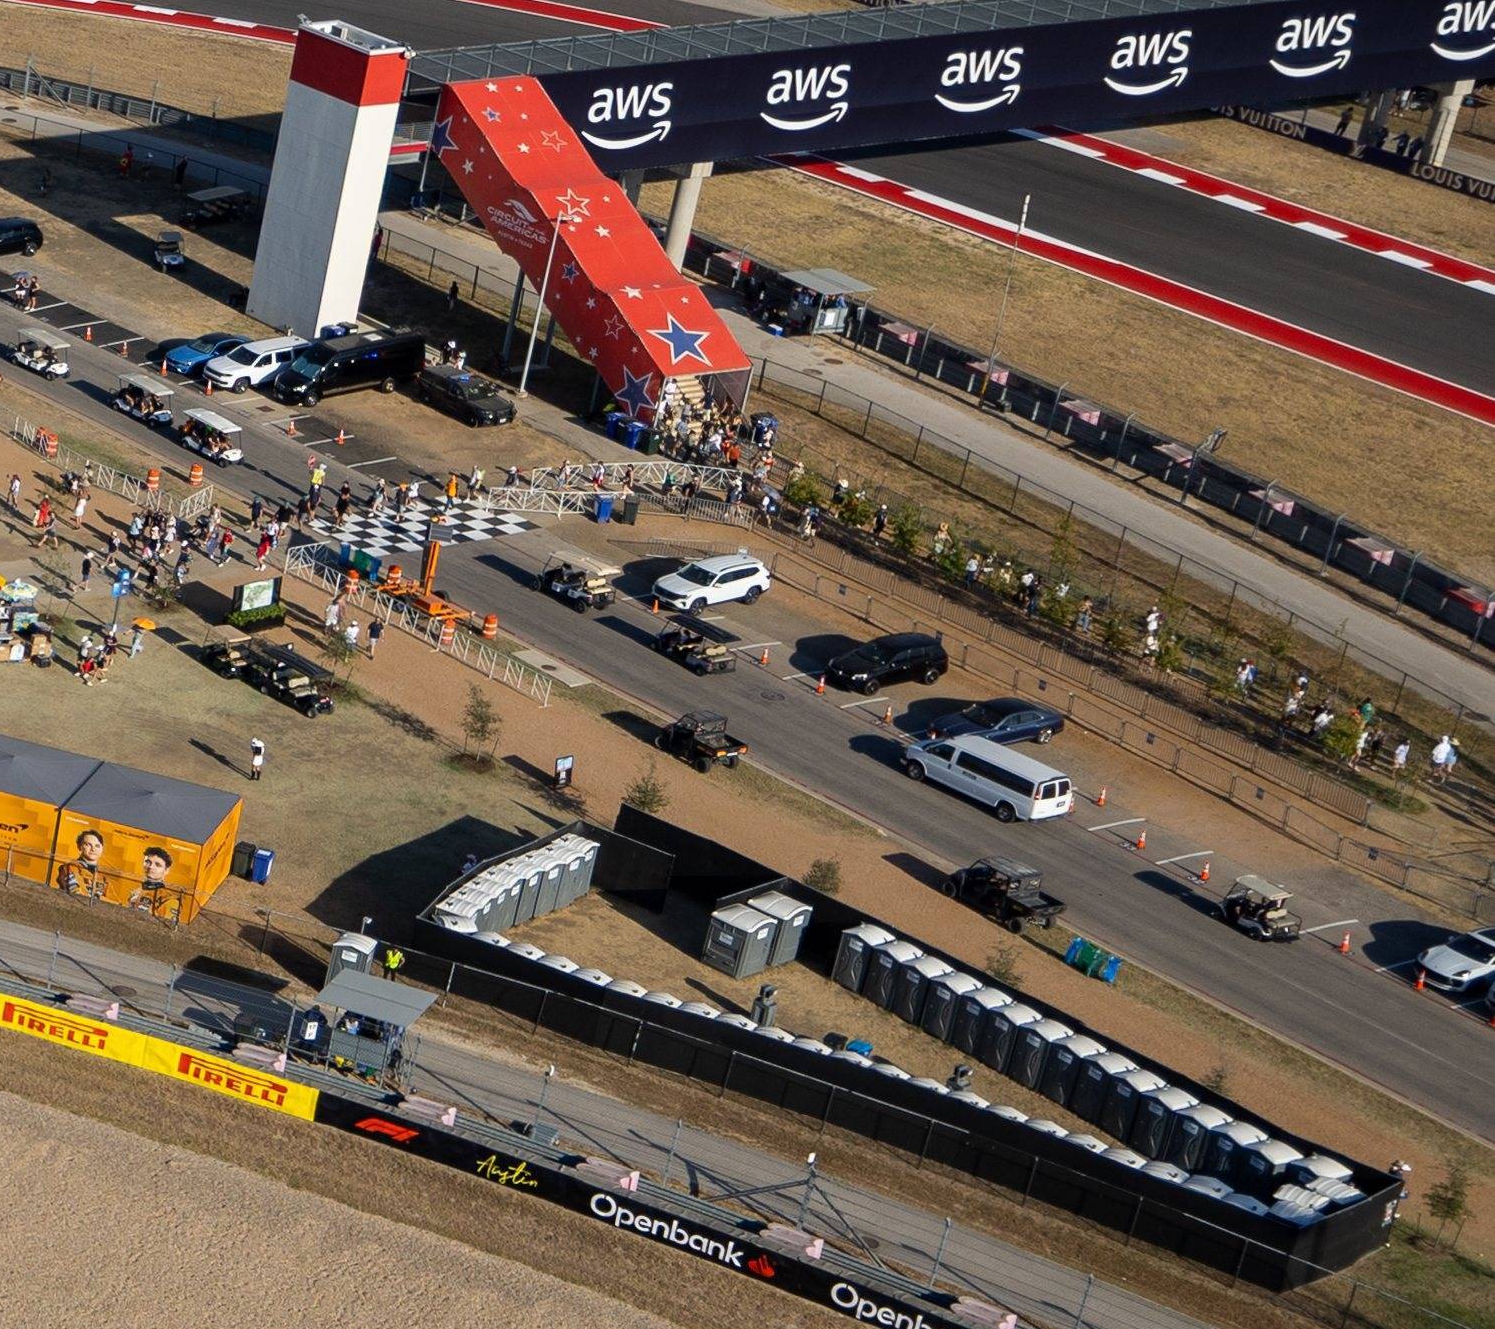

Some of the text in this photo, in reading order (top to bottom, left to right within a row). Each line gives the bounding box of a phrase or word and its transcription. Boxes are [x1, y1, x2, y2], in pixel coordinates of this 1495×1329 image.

[1110, 31, 1193, 70] aws
[1277, 14, 1356, 52] aws
[767, 64, 851, 105] aws
[941, 46, 1024, 87] aws
[588, 83, 674, 123] aws
[1411, 159, 1463, 190] LOUIS
[2, 1001, 110, 1050] PIRELLI
[178, 1051, 289, 1107] PIRELLI
[475, 1153, 542, 1191] Austin
[589, 1191, 744, 1271] Openbank
